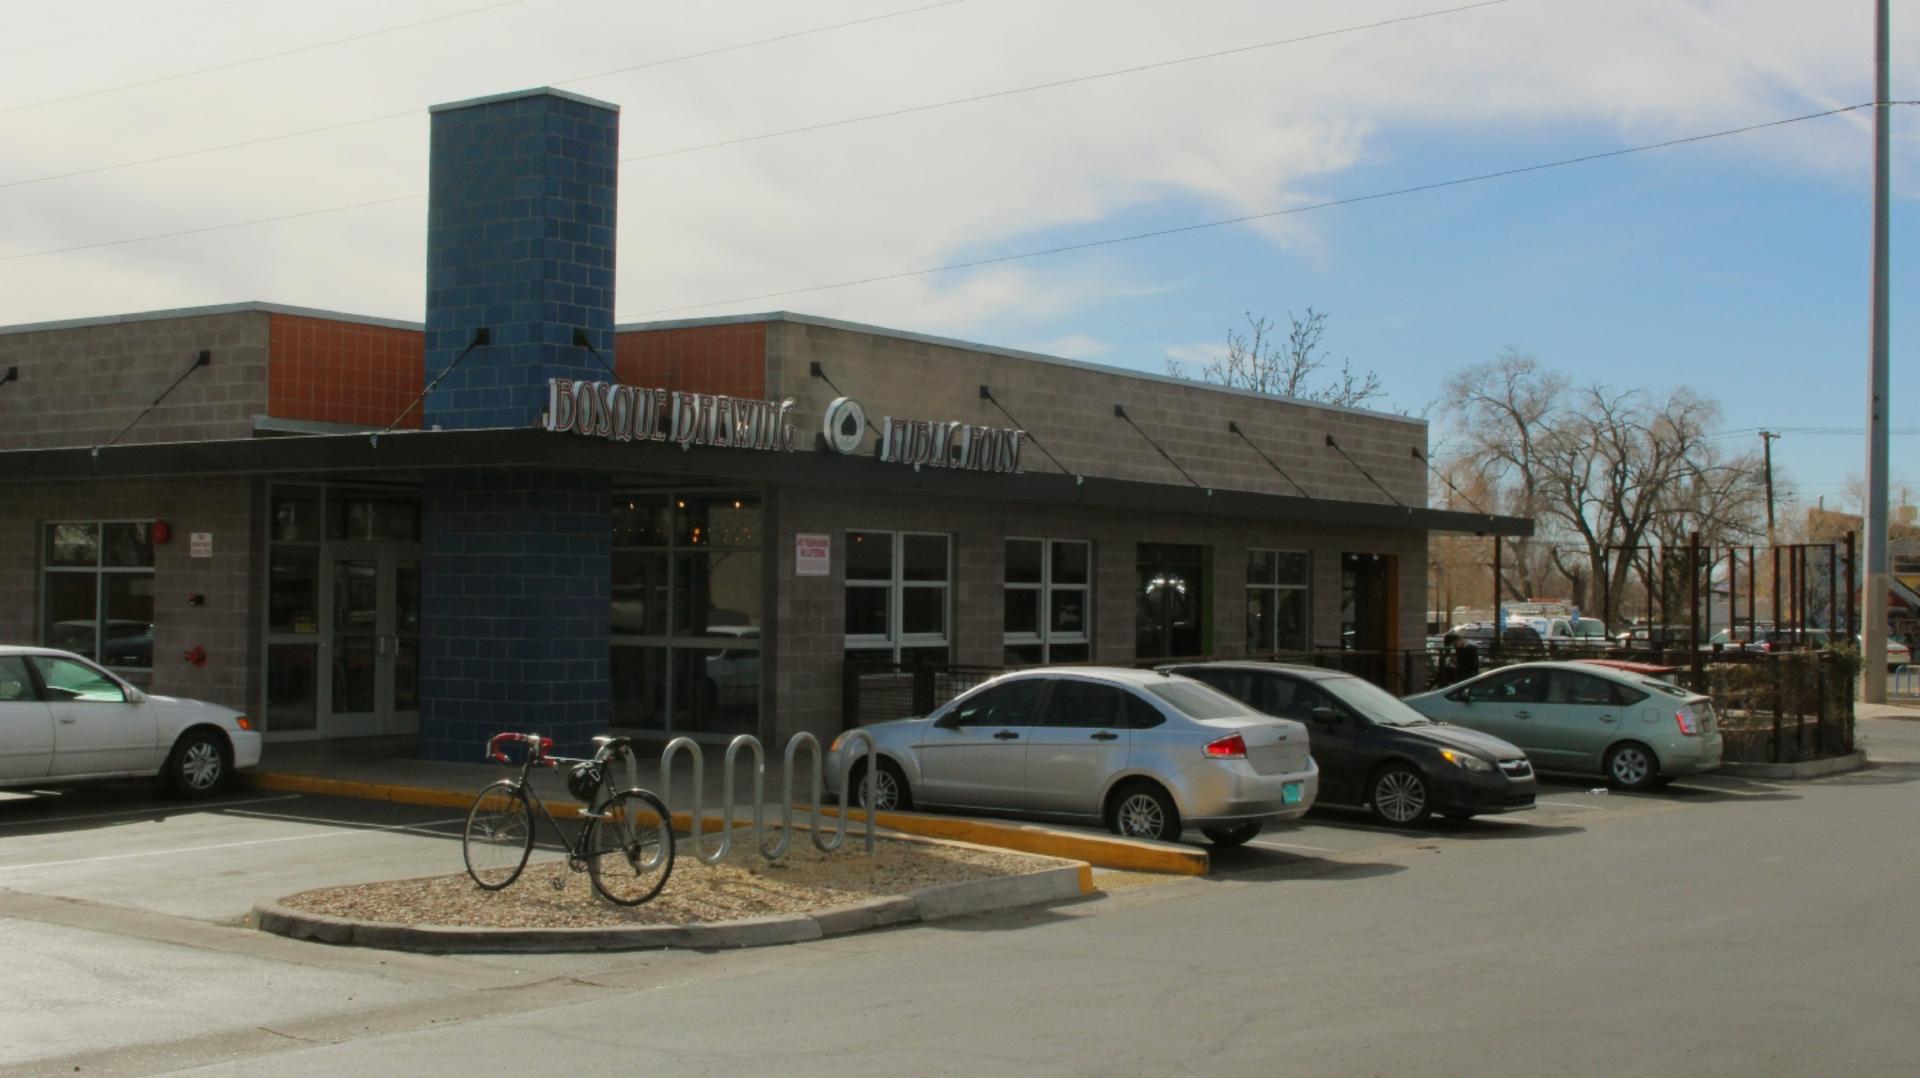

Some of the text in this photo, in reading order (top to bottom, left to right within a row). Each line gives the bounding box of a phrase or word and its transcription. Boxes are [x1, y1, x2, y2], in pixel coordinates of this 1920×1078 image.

[548, 378, 795, 452] BOSQUE BREWING
[880, 416, 961, 468] PUBLIC
